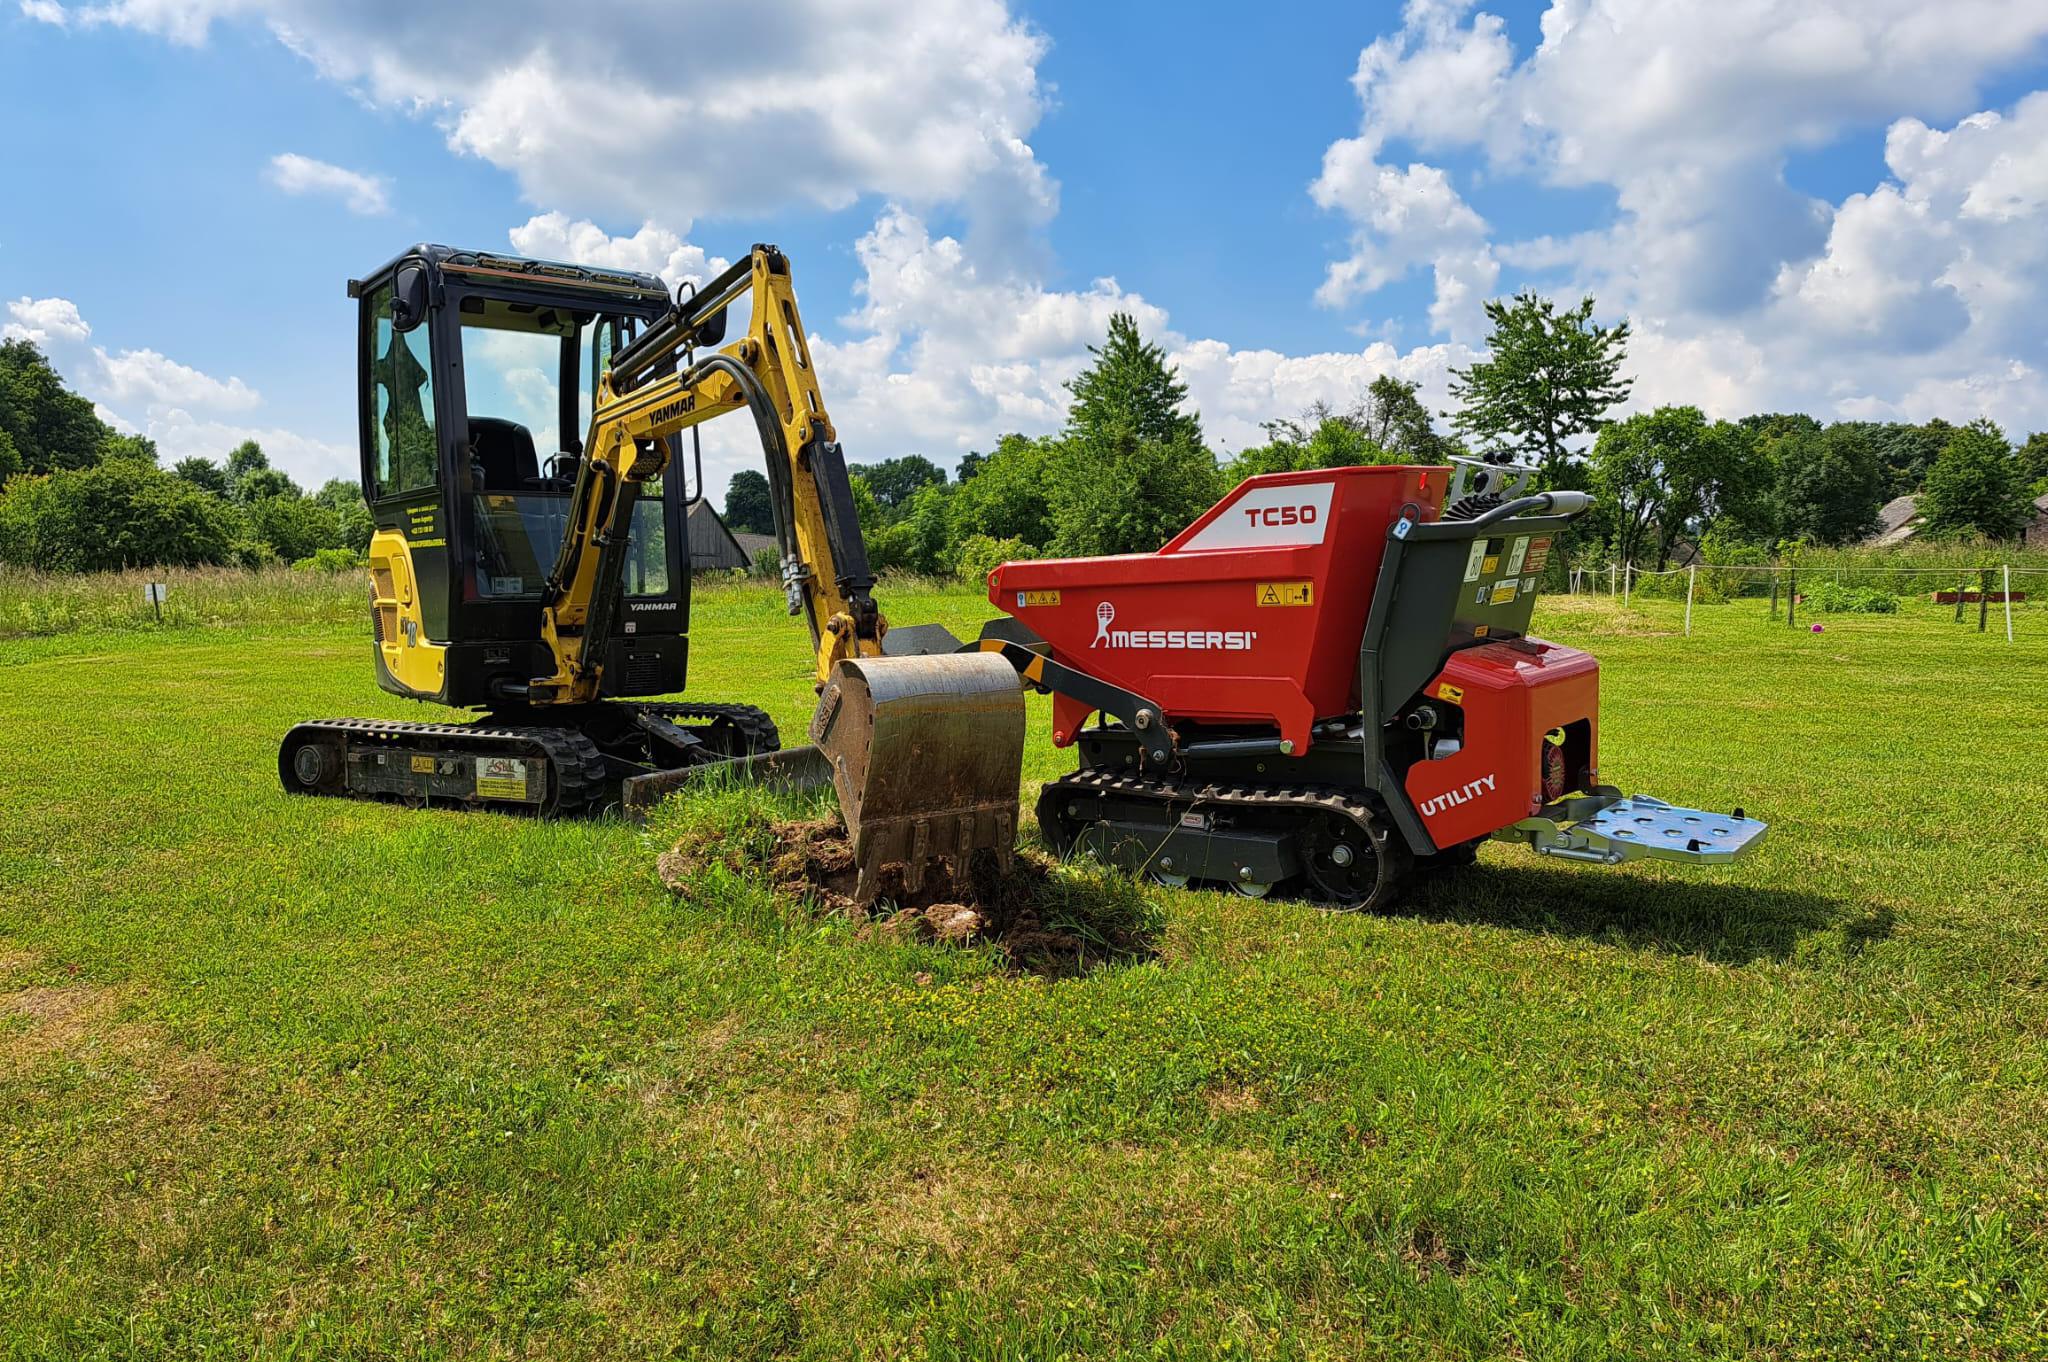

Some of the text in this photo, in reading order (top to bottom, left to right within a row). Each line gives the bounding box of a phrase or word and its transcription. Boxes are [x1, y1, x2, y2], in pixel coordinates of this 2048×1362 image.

[648, 394, 695, 427] YANMAR
[1245, 504, 1317, 528] TC50
[630, 602, 677, 611] YANMAR
[1420, 773, 1496, 817] UTILITY
